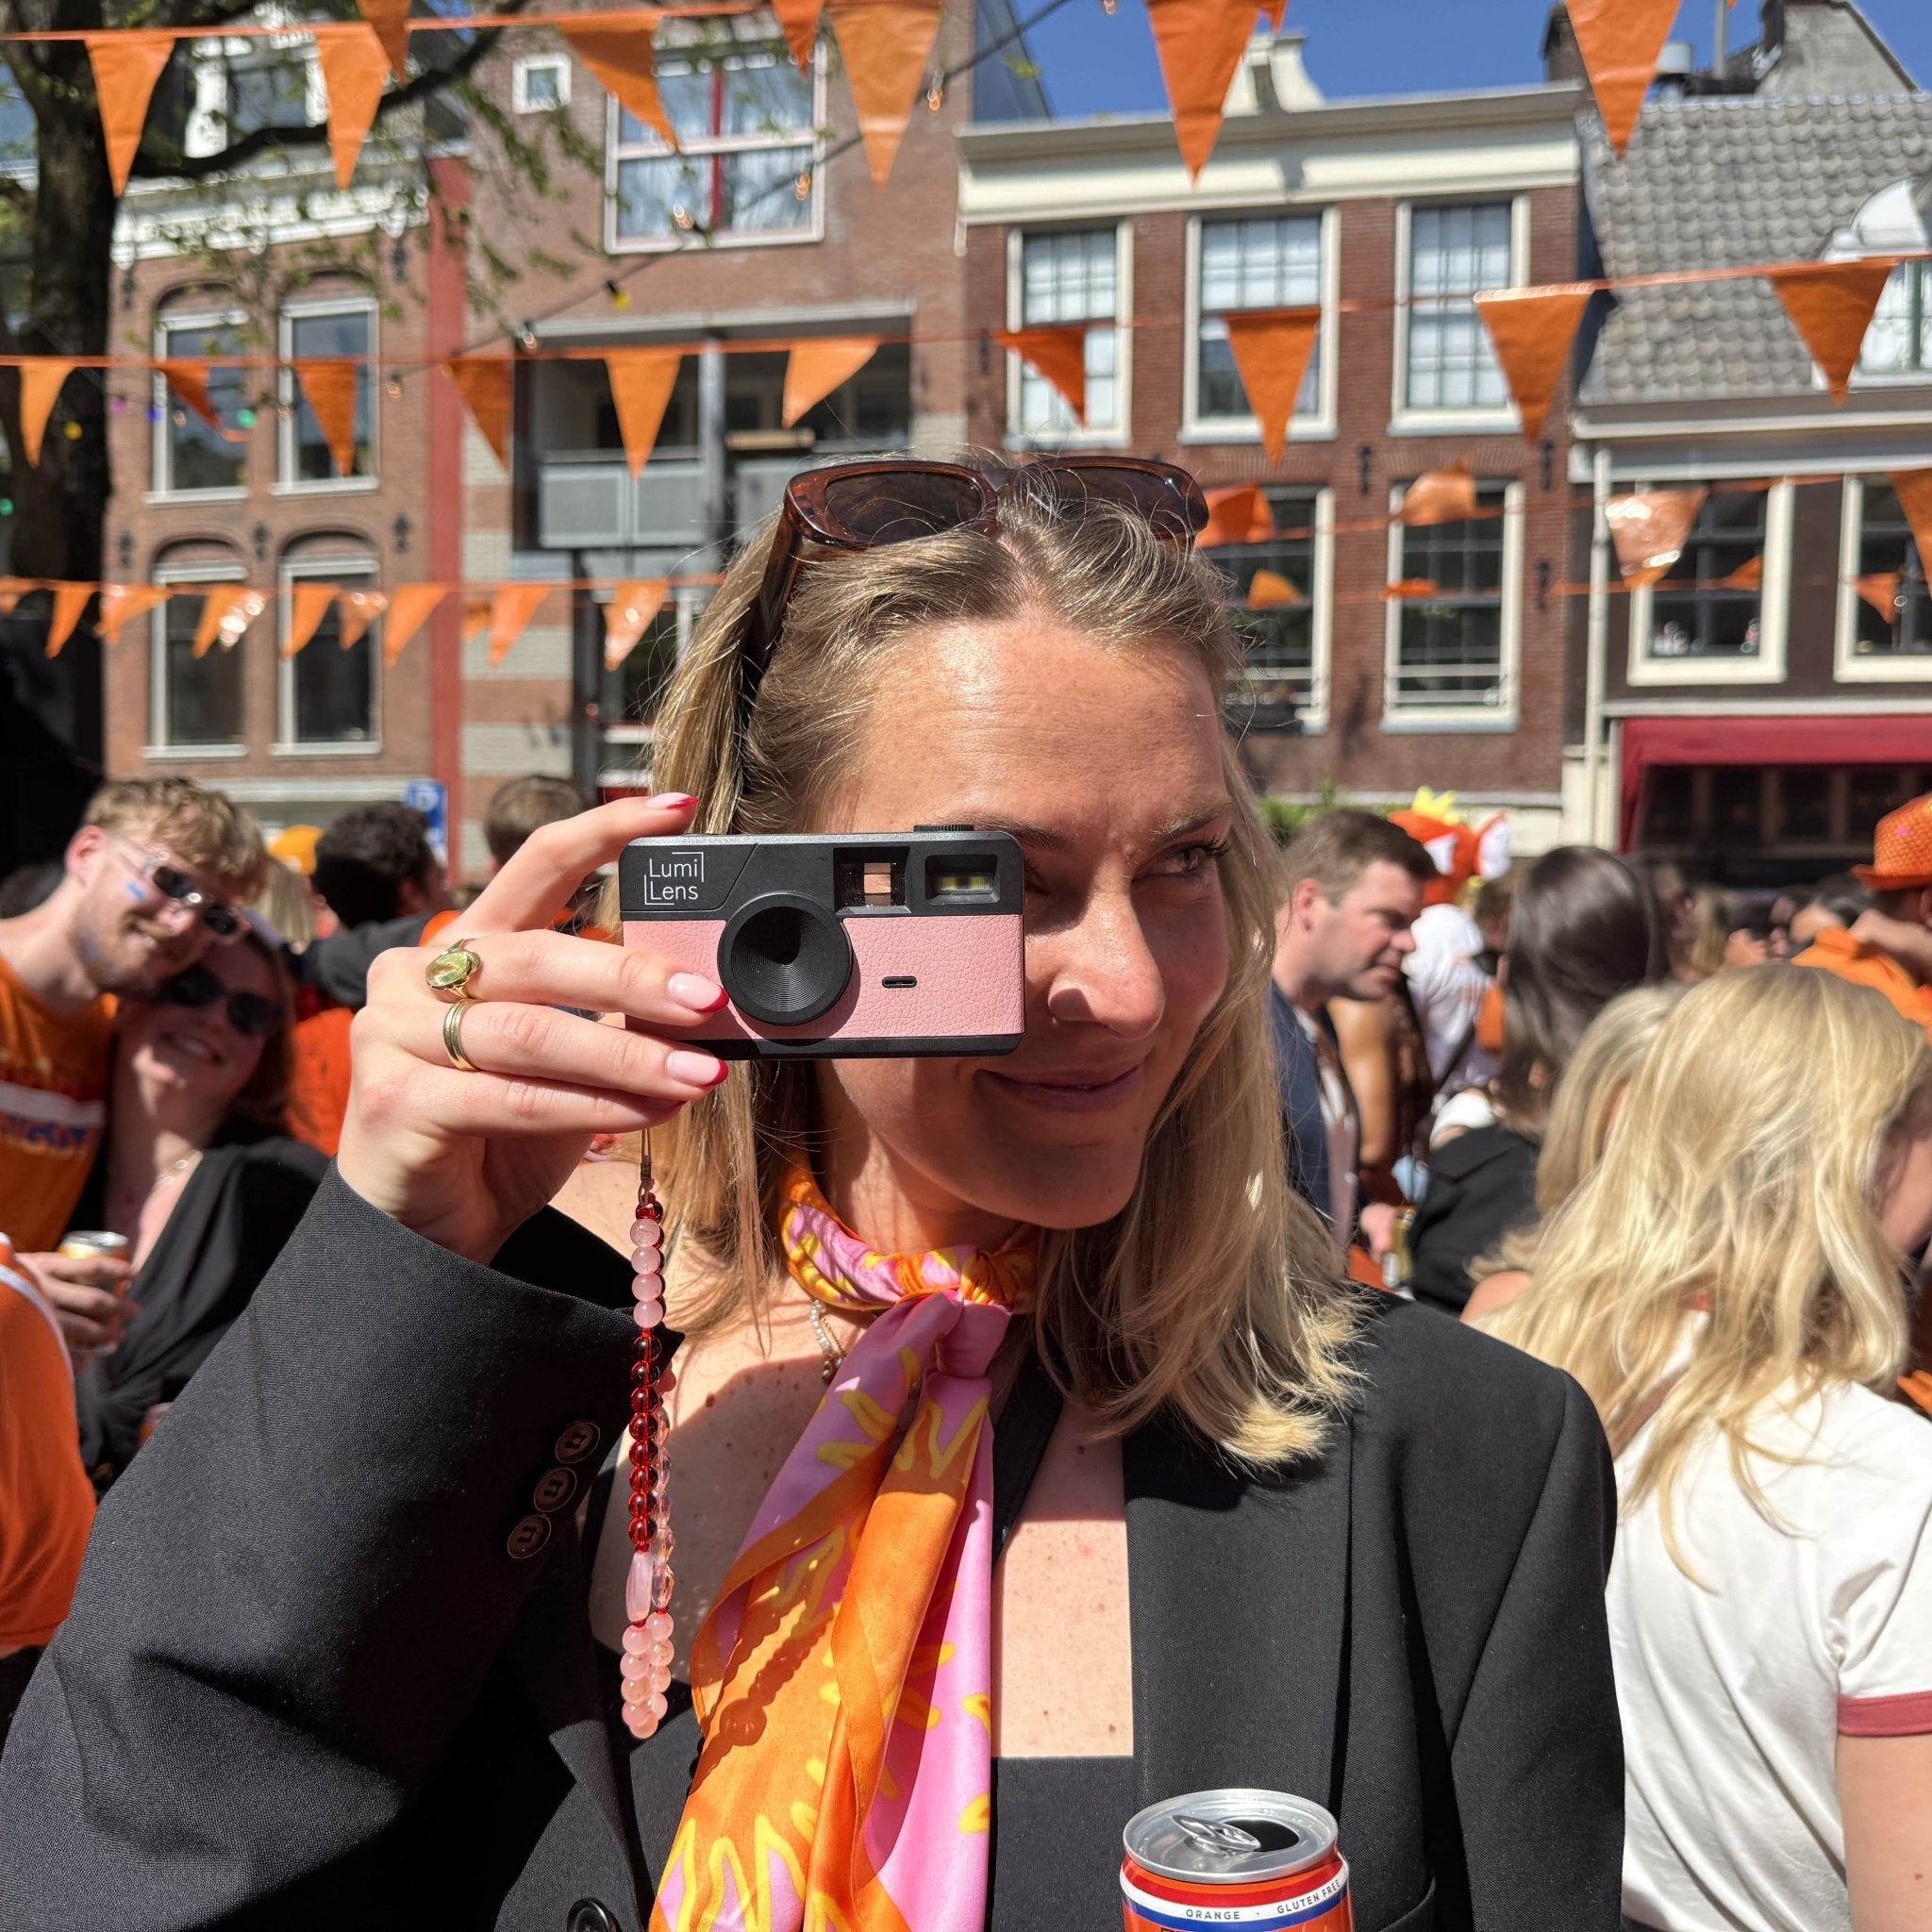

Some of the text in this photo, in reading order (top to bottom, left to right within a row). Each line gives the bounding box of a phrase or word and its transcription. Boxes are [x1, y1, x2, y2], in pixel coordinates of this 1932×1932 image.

[649, 858, 698, 877] Lumi
[650, 880, 699, 900] Lens
[1186, 1878, 1341, 1921] ORANGE GLUTEN FREE
